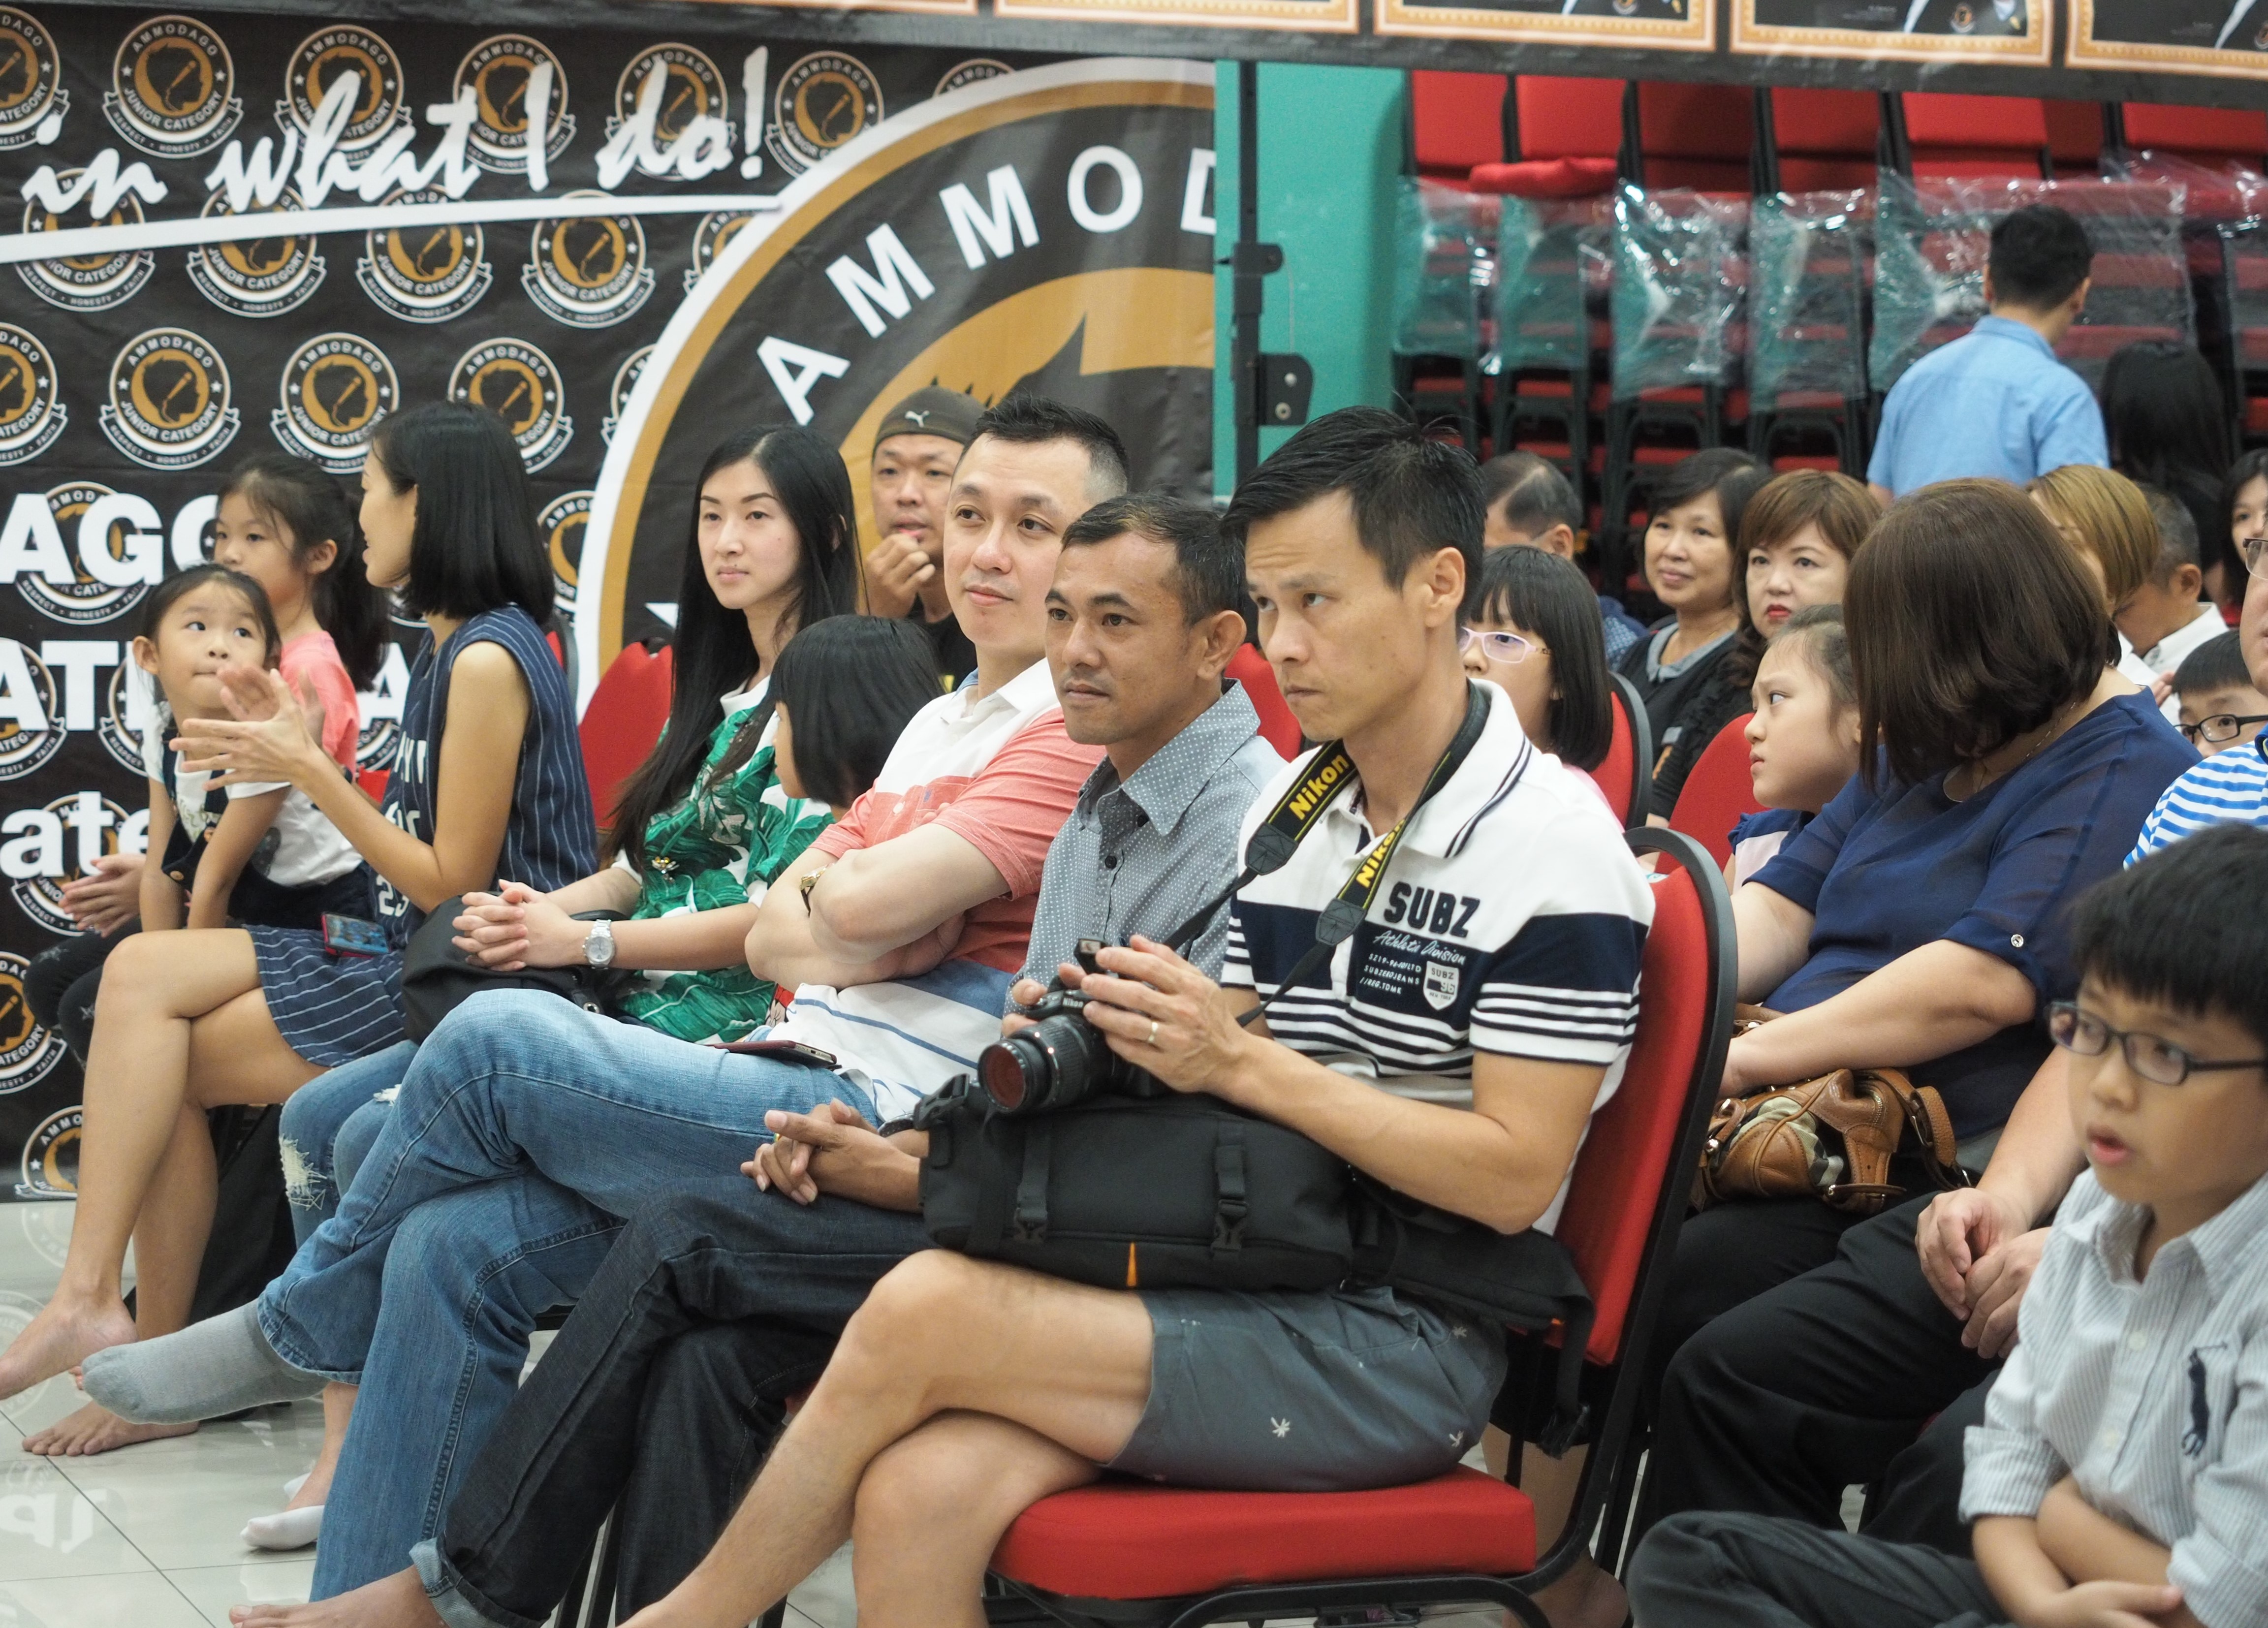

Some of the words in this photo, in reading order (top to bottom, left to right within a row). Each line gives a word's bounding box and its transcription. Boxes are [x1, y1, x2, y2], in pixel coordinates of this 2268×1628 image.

[132, 24, 218, 56] AMMODAGO
[304, 33, 388, 66] AMMODAGO
[472, 41, 546, 71] AMMODAG
[124, 87, 162, 127] JUNIOR
[163, 90, 222, 130] CATEGORY
[344, 98, 392, 139] ATEGORY
[20, 113, 169, 219] in
[205, 69, 480, 212] what
[524, 61, 554, 192] I
[594, 45, 769, 190] do!
[74, 253, 133, 284] CATEGOR
[208, 248, 246, 287] JUNIOR
[247, 249, 305, 289] CATEGORY
[127, 335, 214, 368] AMMODAGO
[298, 341, 383, 373] AMMODAGO
[465, 345, 548, 378] AMMODAGO
[120, 400, 159, 439] JUNIOR
[160, 400, 220, 442] CATEGORY
[291, 405, 330, 443] JUNIOR
[1289, 754, 1350, 820] Nikon
[1383, 881, 1481, 938] SUBZ
[1431, 967, 1454, 980] SUBZ
[1062, 997, 1084, 1009] Nikon
[40, 1114, 83, 1146] AMMO
